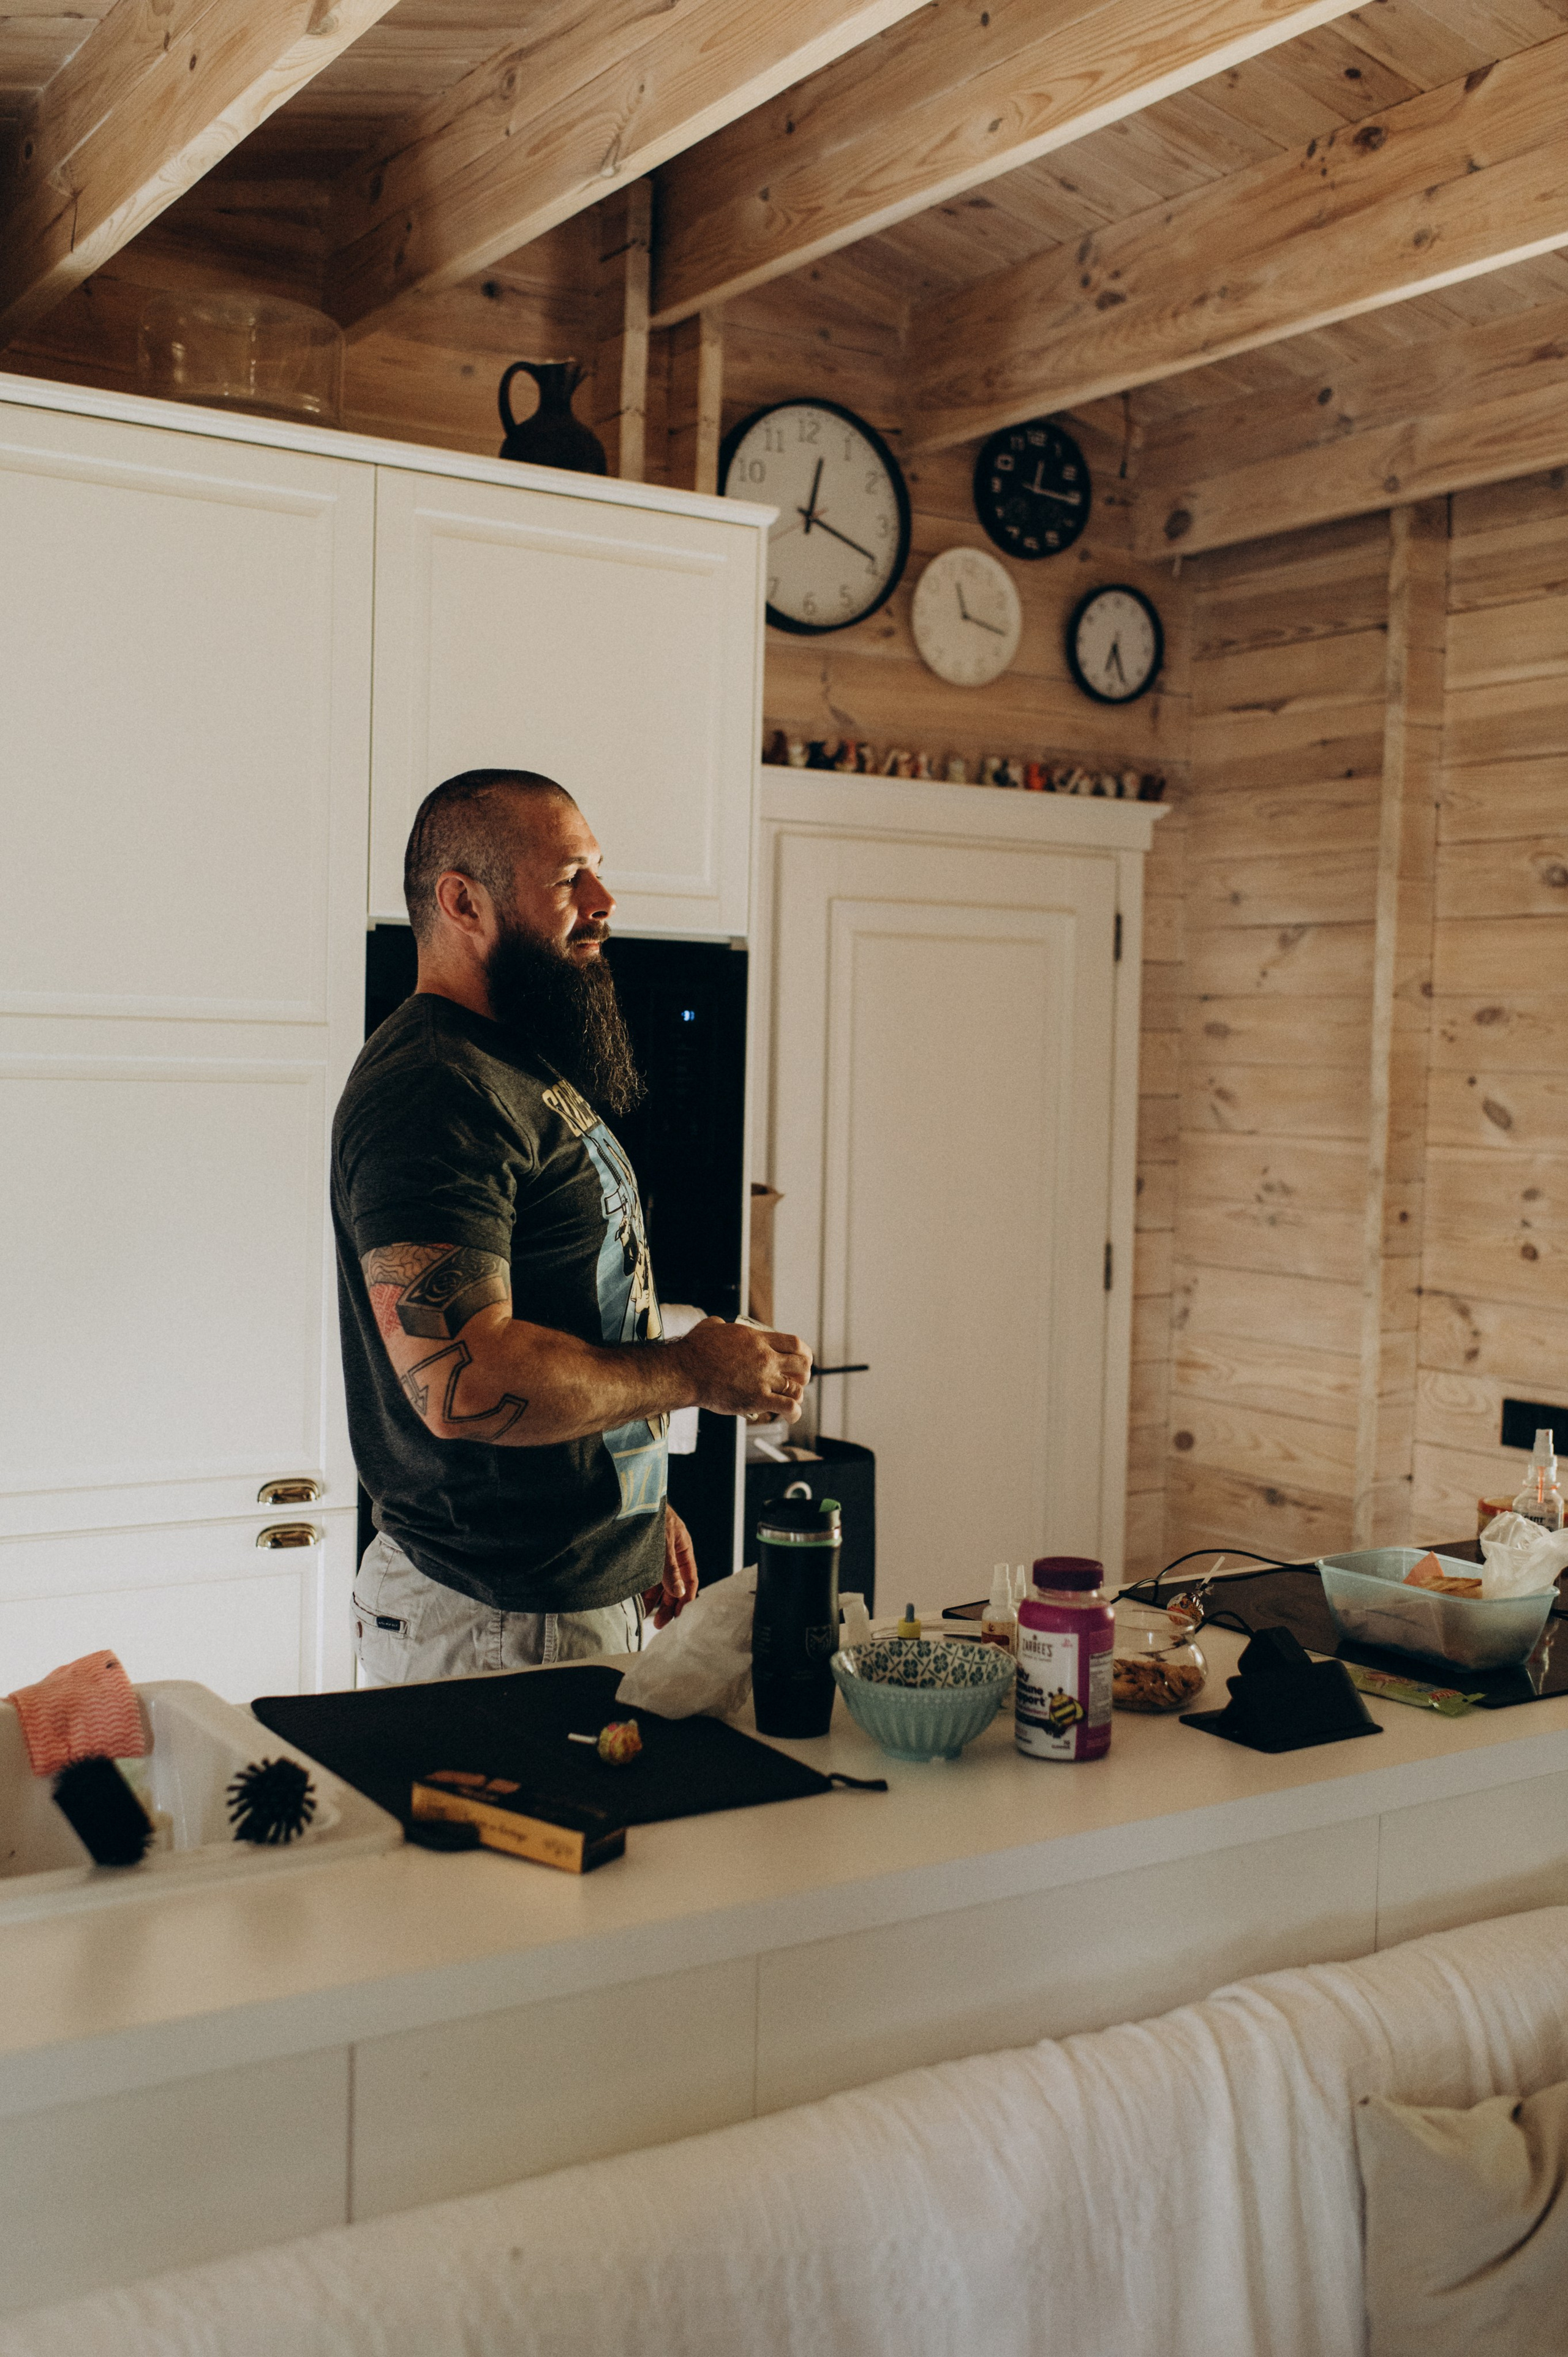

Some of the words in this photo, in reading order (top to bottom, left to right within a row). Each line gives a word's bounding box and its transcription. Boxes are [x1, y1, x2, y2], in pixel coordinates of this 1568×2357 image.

[765, 429, 786, 454] 11
[798, 420, 821, 445] 12
[843, 436, 852, 462] 1
[737, 458, 766, 484] 10
[865, 470, 879, 495] 2
[876, 515, 889, 539] 3
[802, 592, 816, 617] 6
[839, 584, 854, 609] 5
